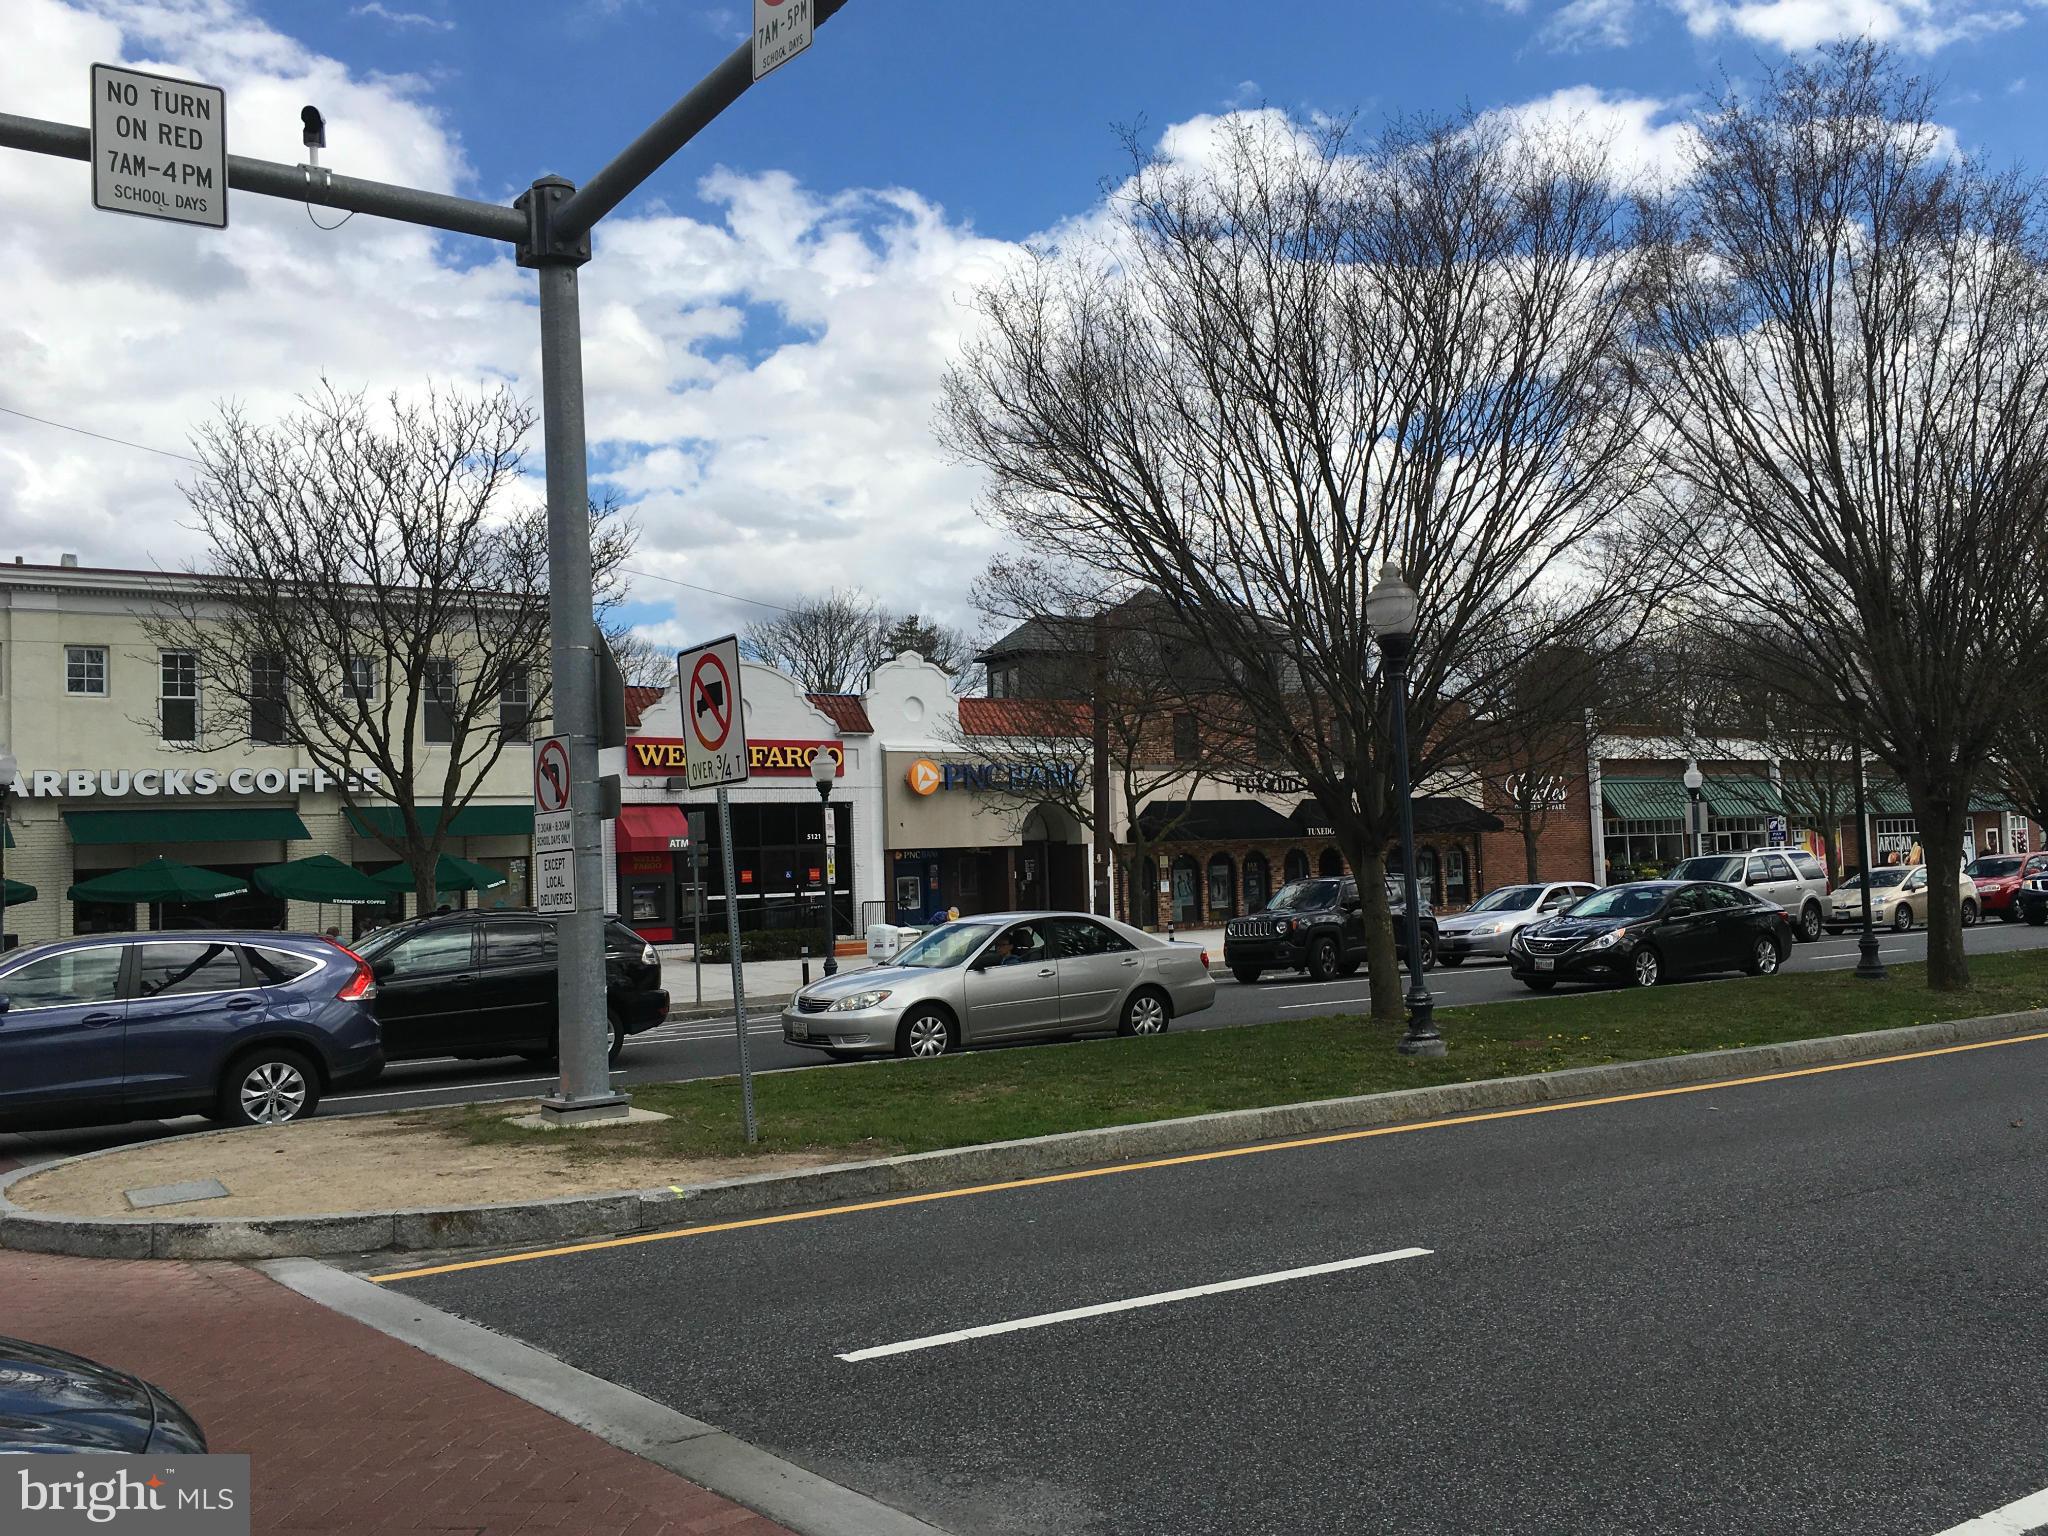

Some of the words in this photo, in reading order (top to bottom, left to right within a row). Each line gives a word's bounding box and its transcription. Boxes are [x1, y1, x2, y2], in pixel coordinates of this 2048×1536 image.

[763, 45, 787, 68] SCHOOL
[789, 33, 803, 52] DAYS
[107, 80, 138, 106] NO
[151, 88, 210, 120] TURN
[116, 115, 147, 141] ON
[158, 123, 203, 150] RED
[114, 184, 170, 206] SCHOOL
[175, 195, 208, 212] DAYS
[692, 760, 713, 780] OVER
[735, 755, 740, 772] T
[749, 746, 843, 768] FARGO
[229, 767, 383, 795] COFFEE
[669, 839, 689, 848] ATM
[1879, 835, 1912, 851] ARTISAN
[544, 858, 565, 871] EXCEPT
[904, 851, 920, 859] PNC
[546, 876, 565, 888] LOCAL
[540, 892, 572, 906] DELIVERIES
